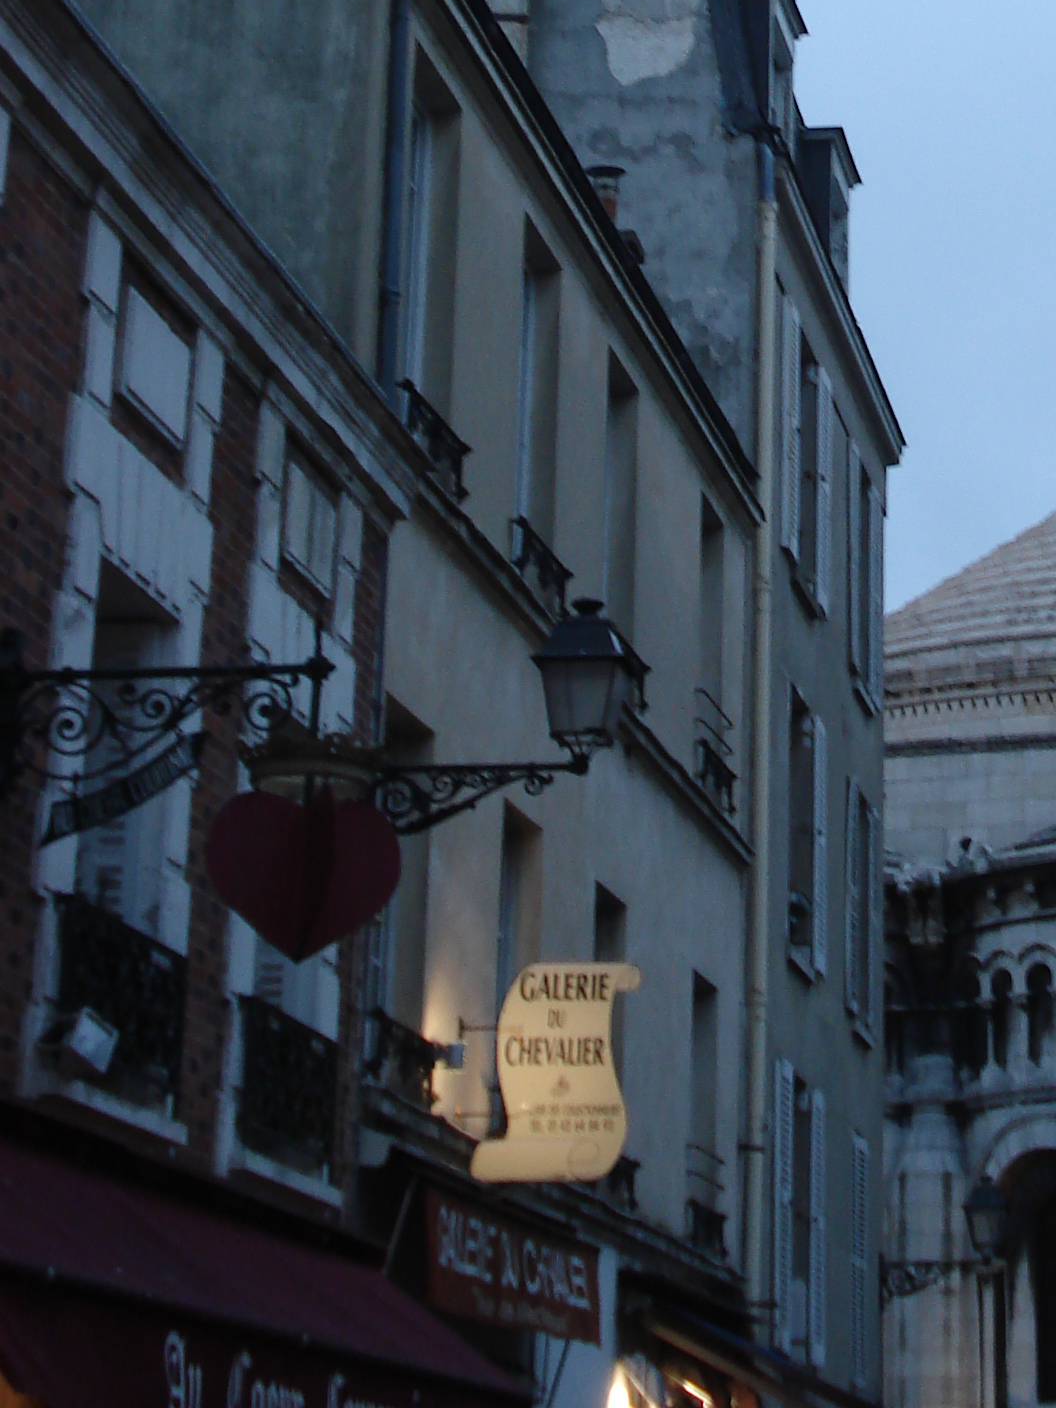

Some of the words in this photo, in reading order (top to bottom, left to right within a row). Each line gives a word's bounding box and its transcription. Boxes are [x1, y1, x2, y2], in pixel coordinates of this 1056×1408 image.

[519, 973, 611, 1002] GALERIE
[547, 1008, 567, 1029] DU
[504, 1036, 606, 1067] CHEVALIER
